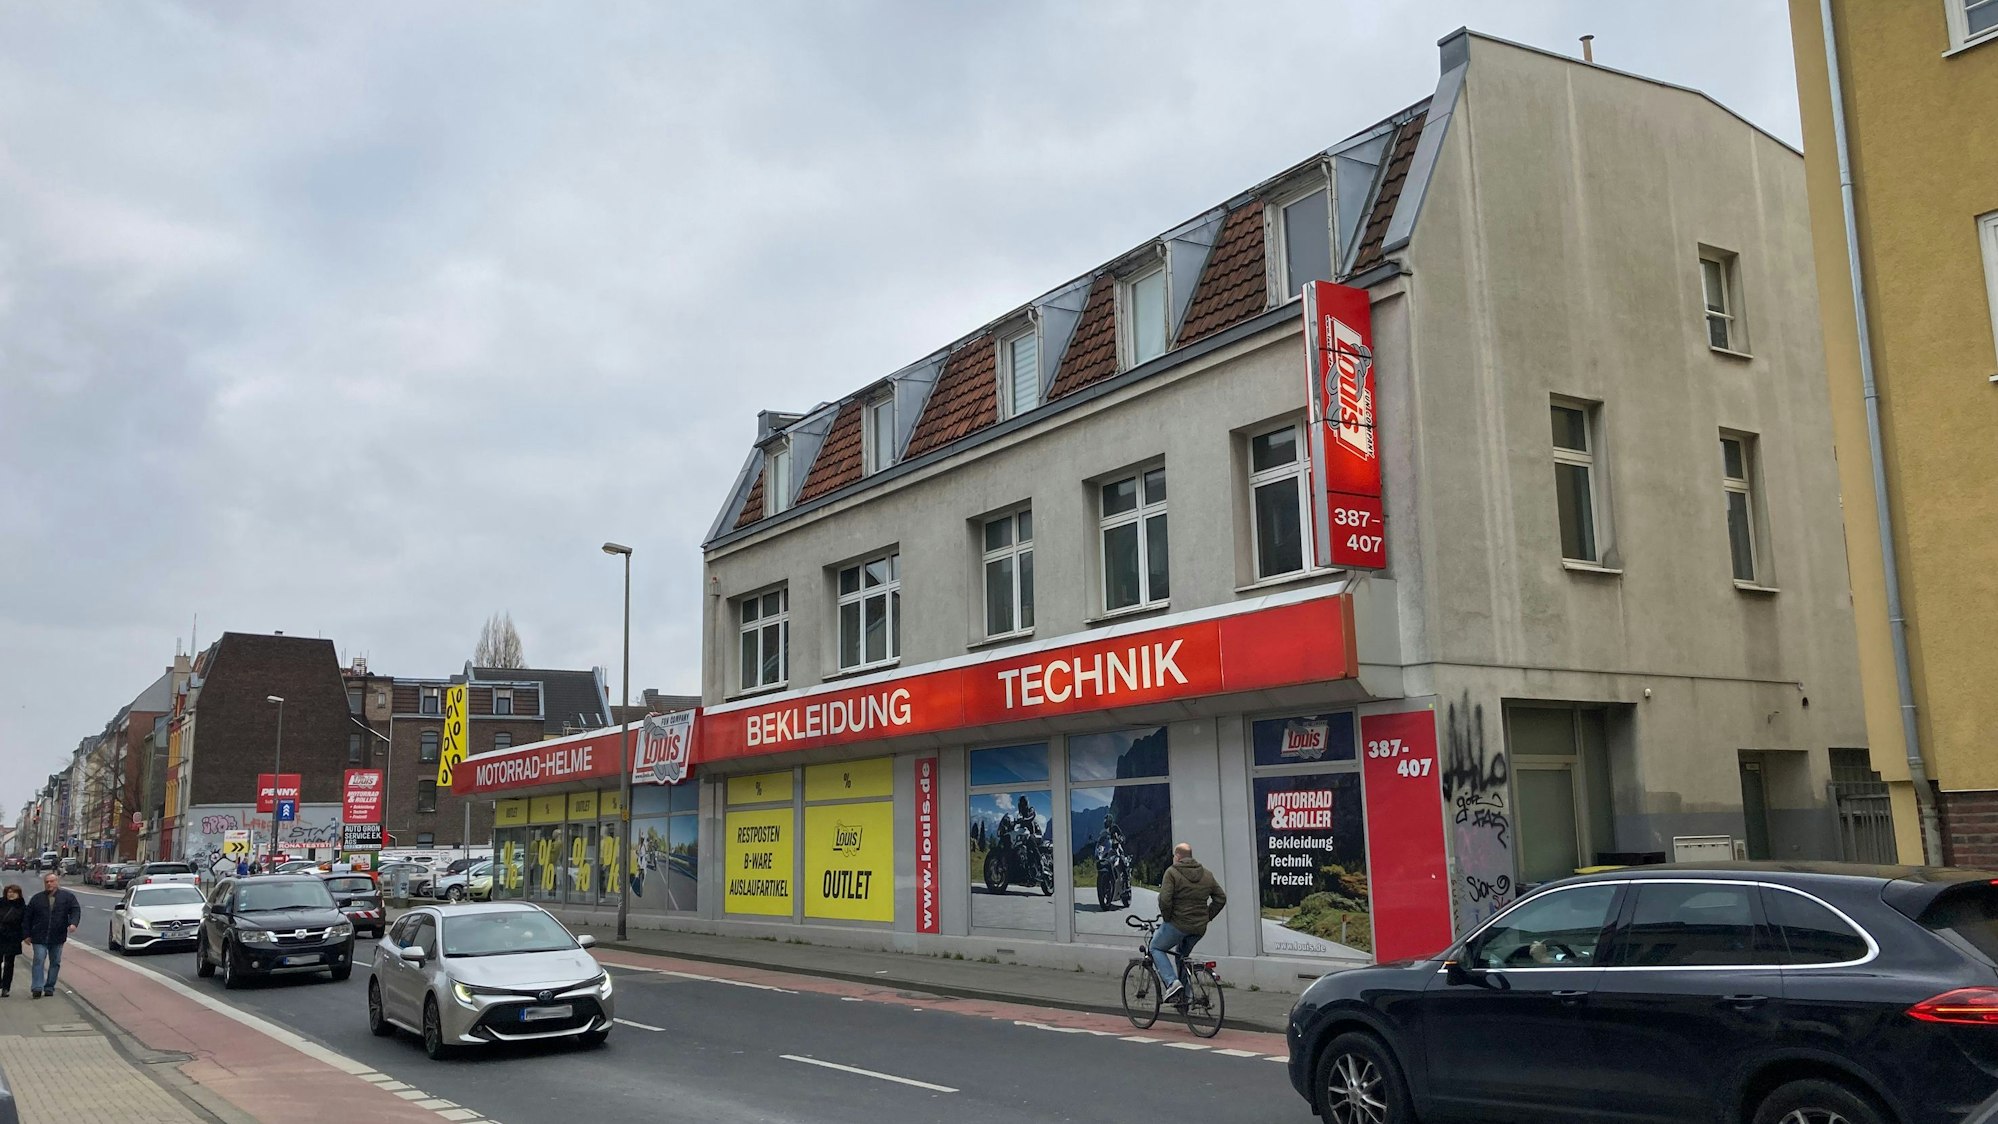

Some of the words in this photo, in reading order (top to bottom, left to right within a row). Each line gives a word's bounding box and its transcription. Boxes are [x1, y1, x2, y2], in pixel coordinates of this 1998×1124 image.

[1334, 507, 1381, 528] 387-
[1346, 533, 1383, 553] 407
[997, 639, 1189, 709] TECHNIK
[661, 717, 669, 726] FUN
[670, 712, 690, 724] COMPANY
[747, 688, 912, 747] BEKLEIDUNG
[643, 728, 681, 764] Louis
[1288, 729, 1321, 749] Louis
[1368, 739, 1410, 758] 387-
[476, 746, 593, 787] MOTORRAD-HELME
[1396, 758, 1433, 777] 407
[1267, 791, 1332, 810] MOTORRAD
[344, 825, 361, 833] AUTO
[344, 832, 371, 840] SERVICE
[737, 825, 781, 843] RESTPOSTEN
[835, 828, 858, 846] Louis
[919, 762, 933, 930] www.louis.de
[1268, 836, 1334, 852] Bekleidung
[743, 852, 773, 870] B-WARE
[1269, 853, 1313, 867] Technik
[729, 879, 789, 897] AUSLAUFARTIKEL
[823, 870, 872, 900] OUTLET
[1270, 872, 1314, 886] Freizeit
[1273, 941, 1327, 953] www.louis.de
